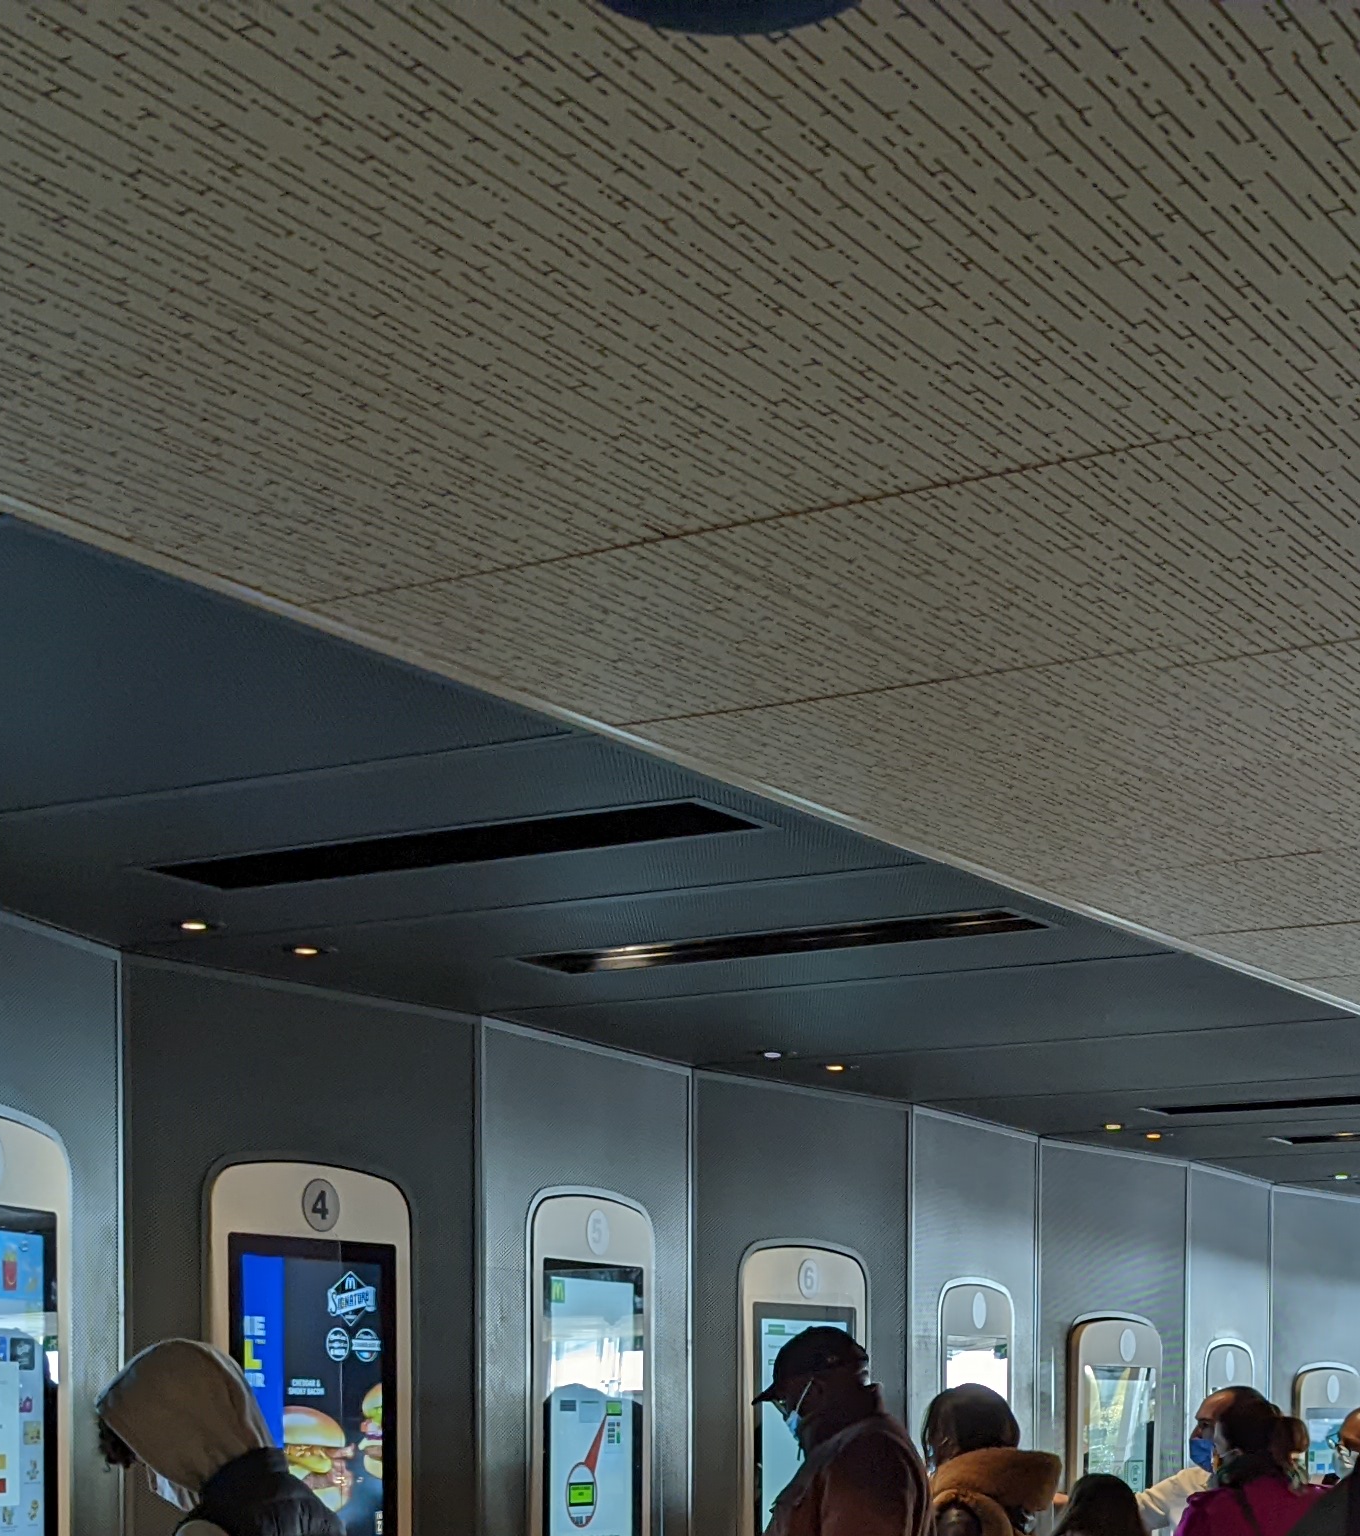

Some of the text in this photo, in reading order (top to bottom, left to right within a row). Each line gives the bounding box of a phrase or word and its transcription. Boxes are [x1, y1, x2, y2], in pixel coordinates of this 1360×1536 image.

[312, 1190, 329, 1220] 4
[592, 1218, 602, 1244] 5
[804, 1266, 815, 1290] 6
